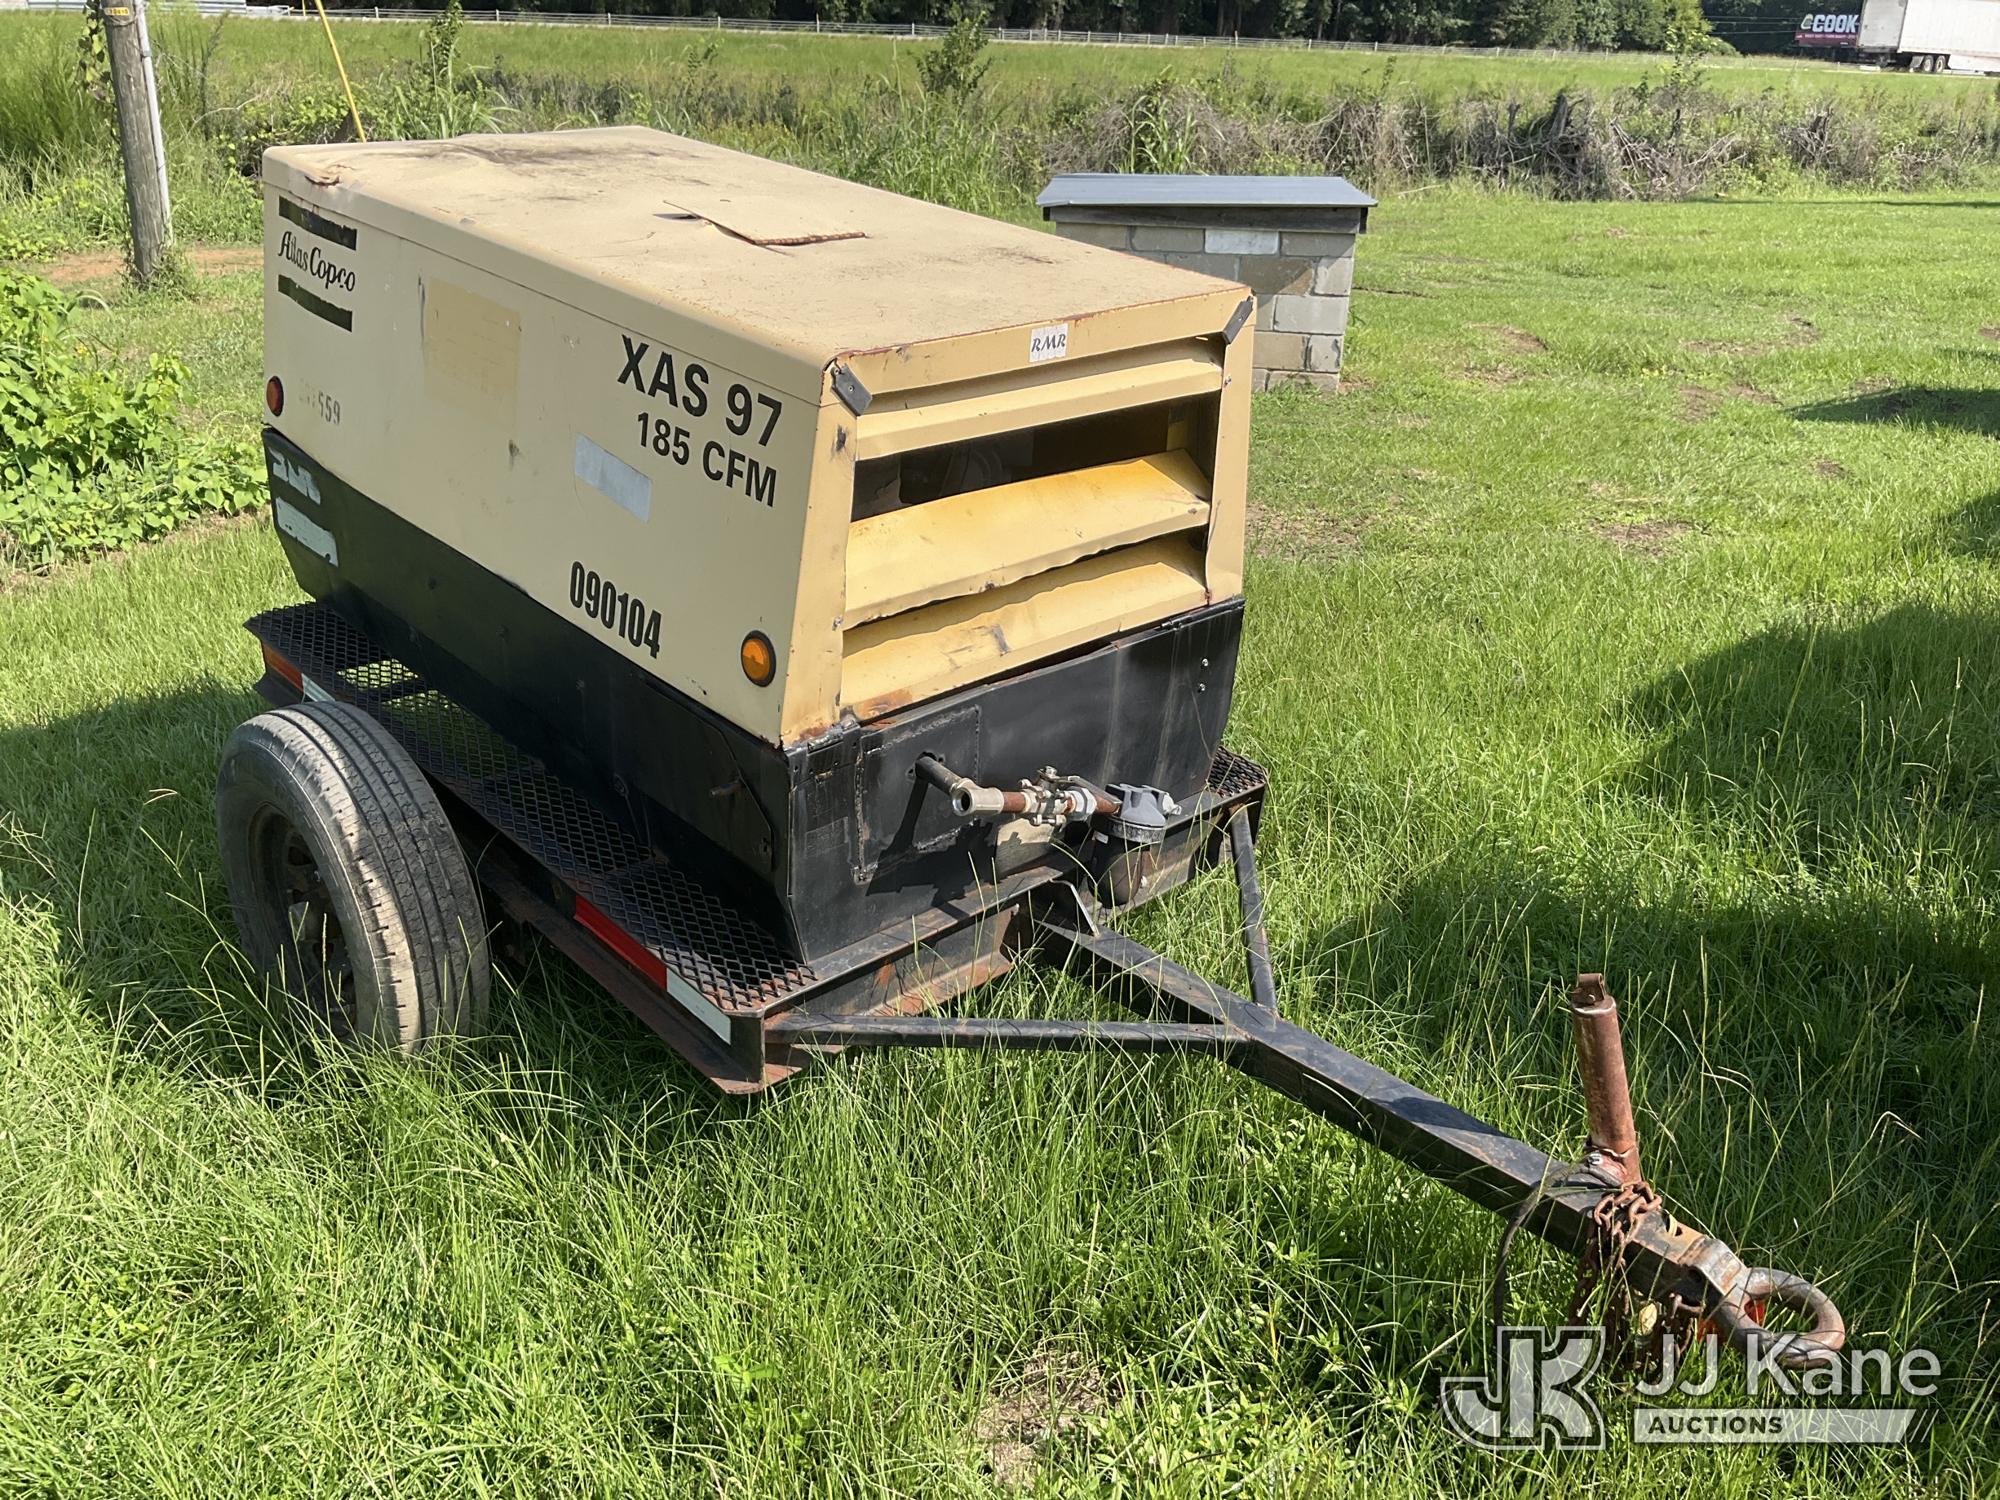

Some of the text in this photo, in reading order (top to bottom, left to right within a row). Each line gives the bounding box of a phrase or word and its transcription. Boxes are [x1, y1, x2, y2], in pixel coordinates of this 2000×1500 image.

[1812, 14, 1860, 33] COOK
[278, 231, 356, 292] Atlas Copco
[1031, 333, 1066, 353] RMR
[617, 334, 783, 447] XAS 97
[637, 411, 777, 508] 185 CFM
[569, 560, 662, 660] 090104
